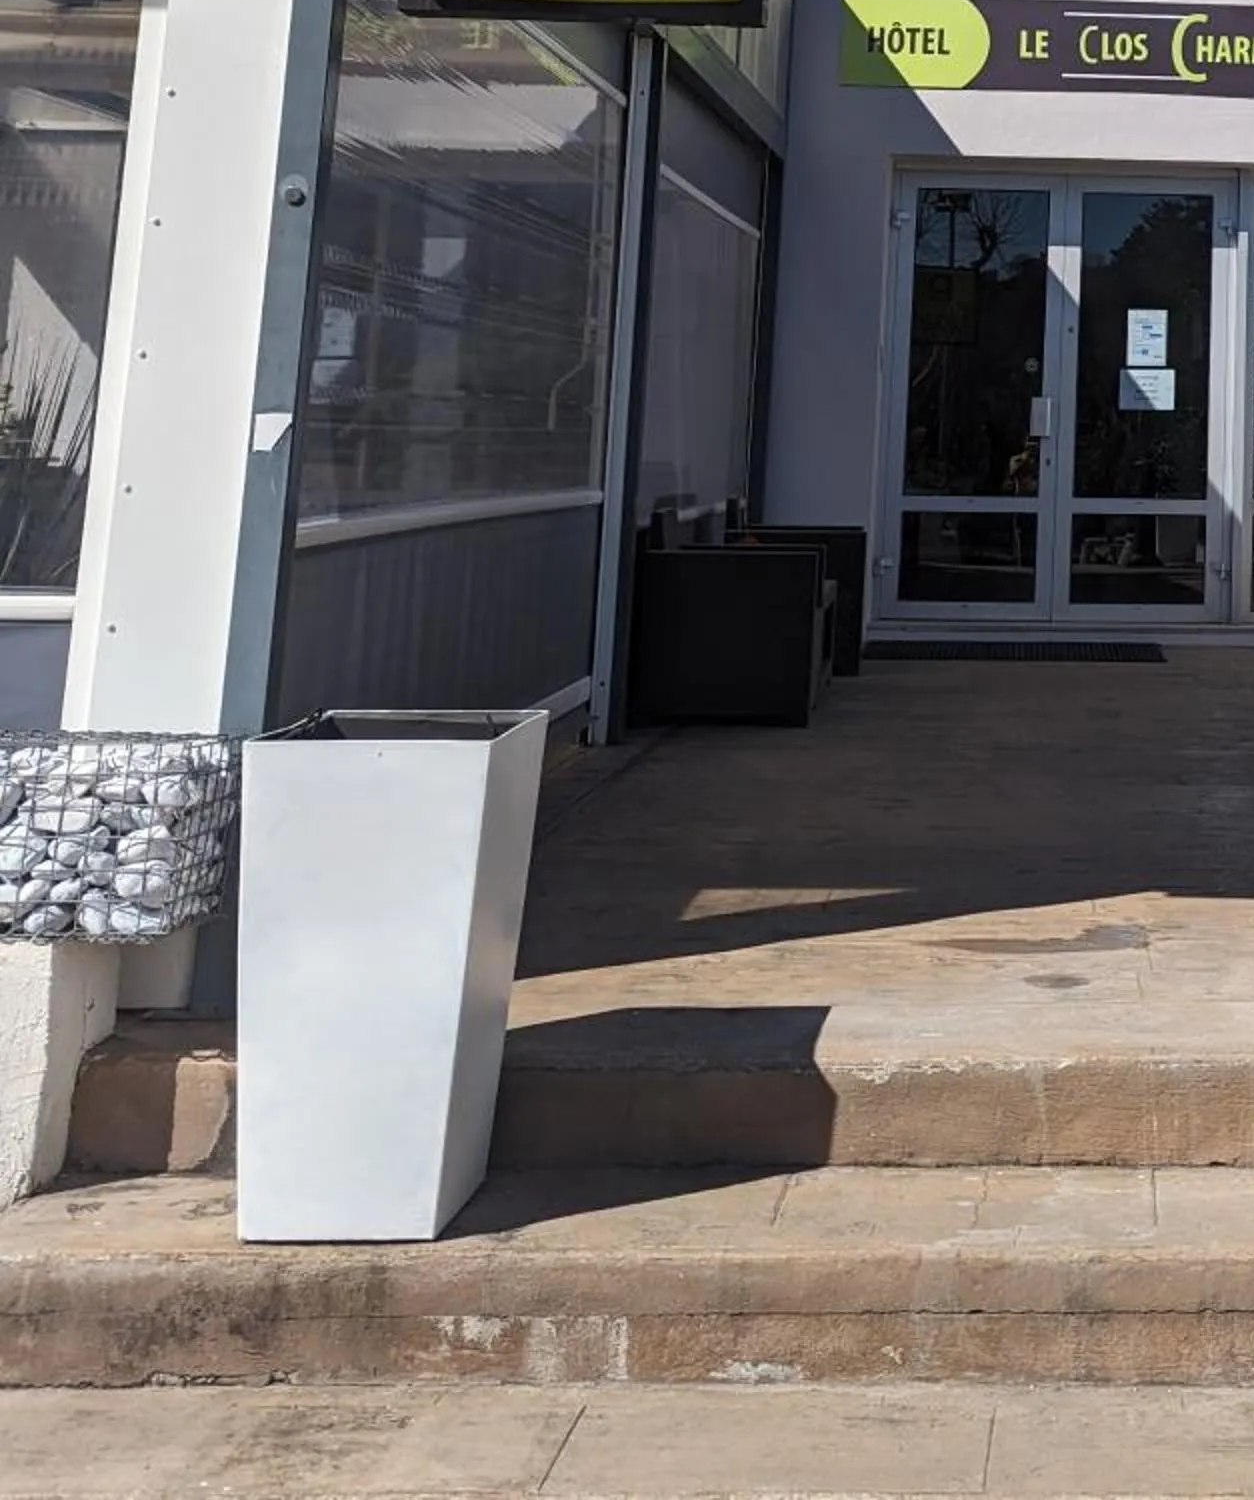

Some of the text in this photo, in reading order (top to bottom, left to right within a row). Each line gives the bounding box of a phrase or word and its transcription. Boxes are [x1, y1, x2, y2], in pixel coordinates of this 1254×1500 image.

[866, 22, 951, 56] HÔTEL
[1018, 29, 1049, 60] LE
[1079, 25, 1149, 65] CLOS
